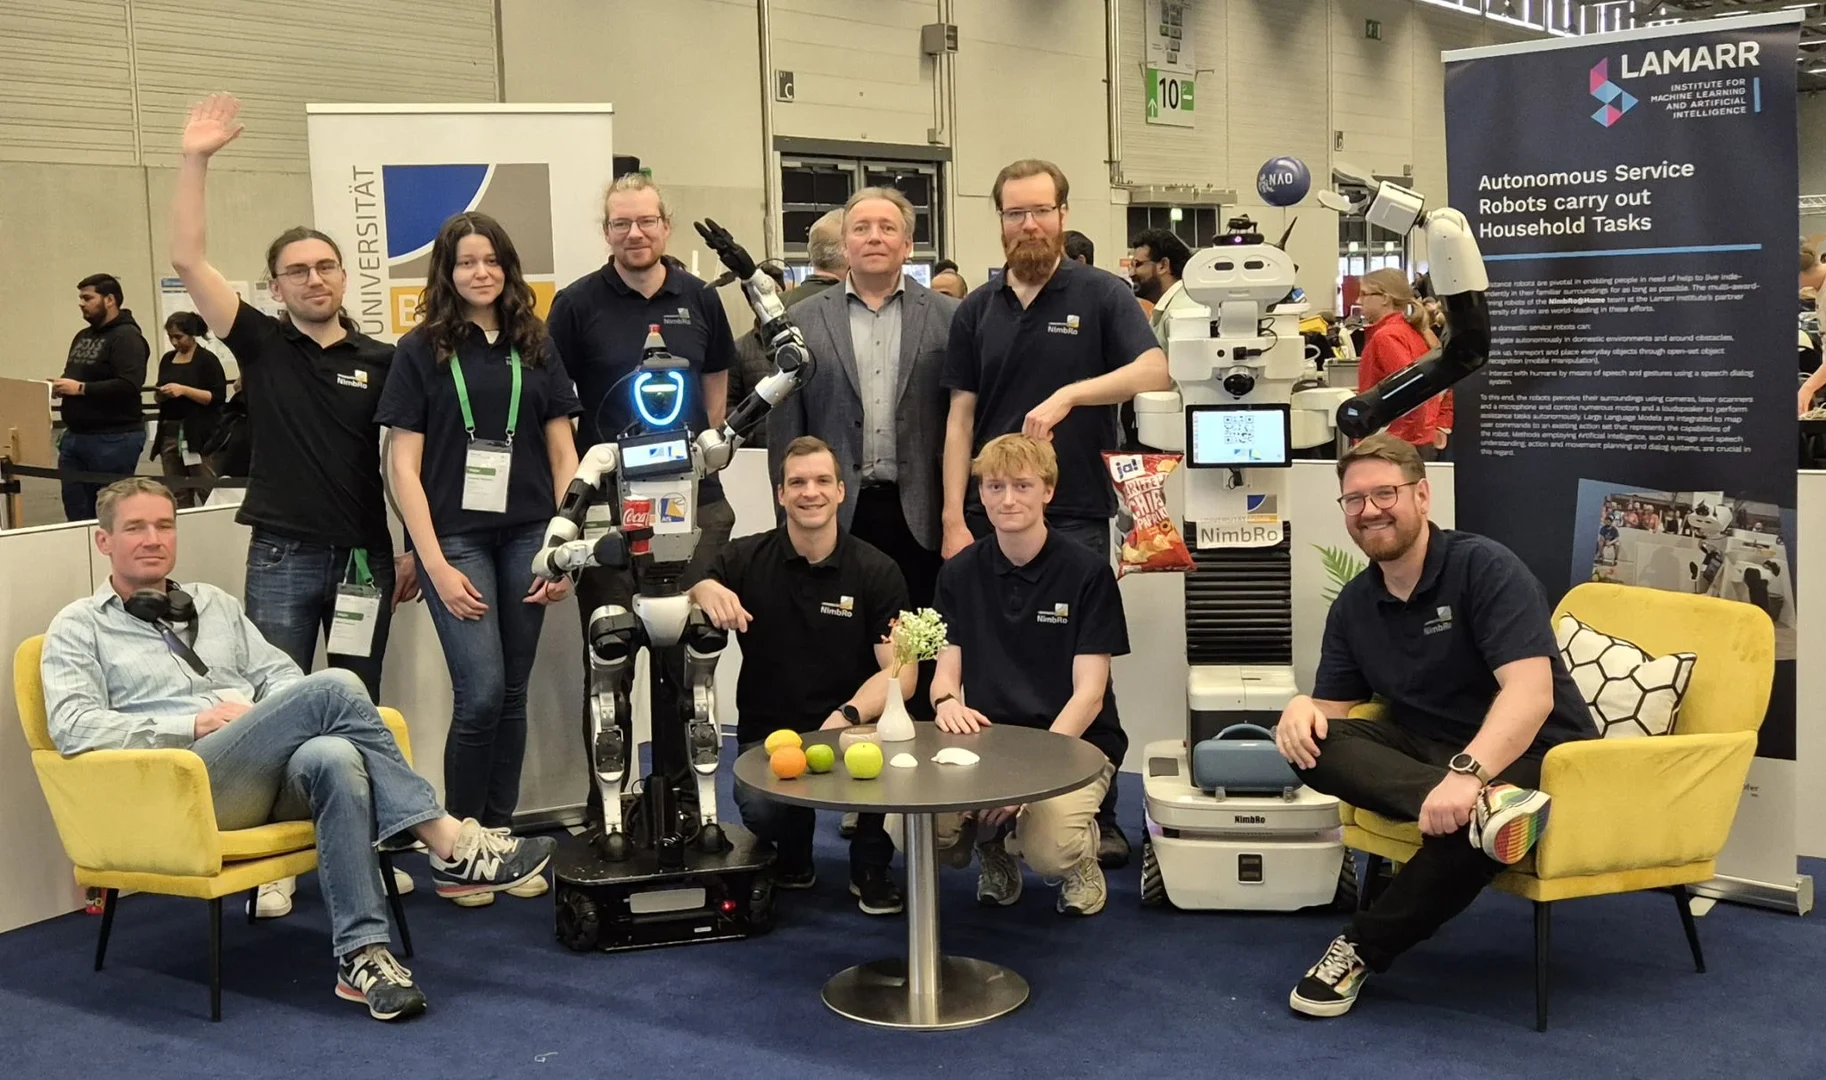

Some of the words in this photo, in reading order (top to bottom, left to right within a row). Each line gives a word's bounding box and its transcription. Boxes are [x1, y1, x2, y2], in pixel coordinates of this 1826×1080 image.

[1621, 40, 1760, 79] LAMARR
[785, 83, 793, 99] C
[1671, 80, 1723, 92] INSTITUTE
[1726, 78, 1746, 87] FOR
[1159, 77, 1179, 110] 10
[1650, 92, 1693, 103] MACHINE
[1696, 87, 1746, 99] LEARNING
[1665, 102, 1687, 111] AND
[1690, 97, 1746, 108] ARTIFICIAL
[1673, 106, 1747, 119] INTELLIGENCE
[1269, 172, 1293, 186] NAO
[1478, 169, 1608, 191] Autonomous
[1615, 160, 1695, 182] Service
[1479, 196, 1547, 215] Robots
[1554, 194, 1608, 212] carry
[1615, 189, 1651, 206] out
[1479, 216, 1585, 239] Household
[1592, 213, 1652, 233] Tasks
[348, 165, 385, 335] UNIVERSITÄT
[1047, 326, 1078, 335] NimbRo
[337, 377, 367, 389] NimbRo
[1115, 458, 1138, 480] ja!
[1128, 489, 1166, 519] CHIP
[623, 508, 648, 527] Coca
[1201, 526, 1278, 543] NimbRo
[821, 606, 852, 618] NimbRo
[1037, 615, 1068, 624] NimbRo
[1234, 815, 1266, 824] NimbRo
